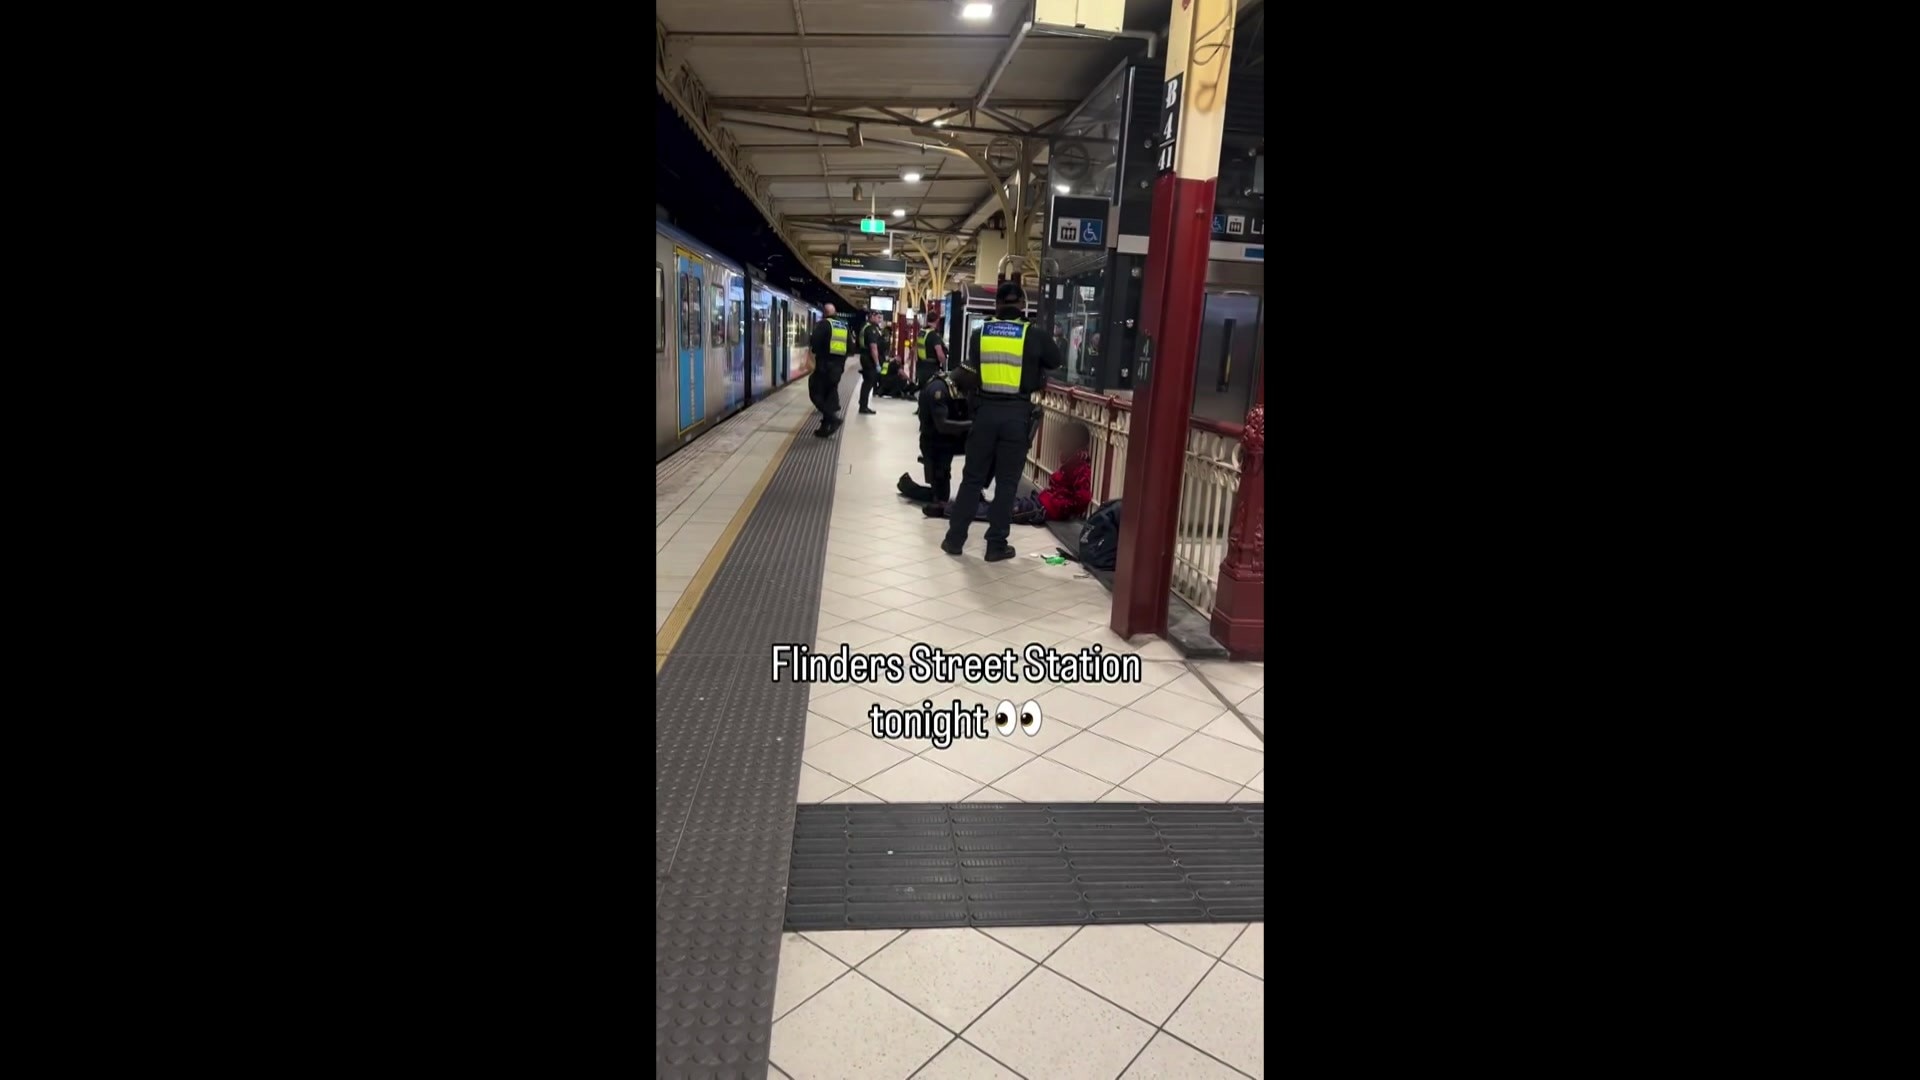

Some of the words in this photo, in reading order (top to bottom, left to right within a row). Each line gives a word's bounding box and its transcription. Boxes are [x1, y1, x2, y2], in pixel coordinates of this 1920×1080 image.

[1166, 79, 1178, 109] B
[1163, 112, 1173, 140] 4
[1158, 145, 1172, 171] 41
